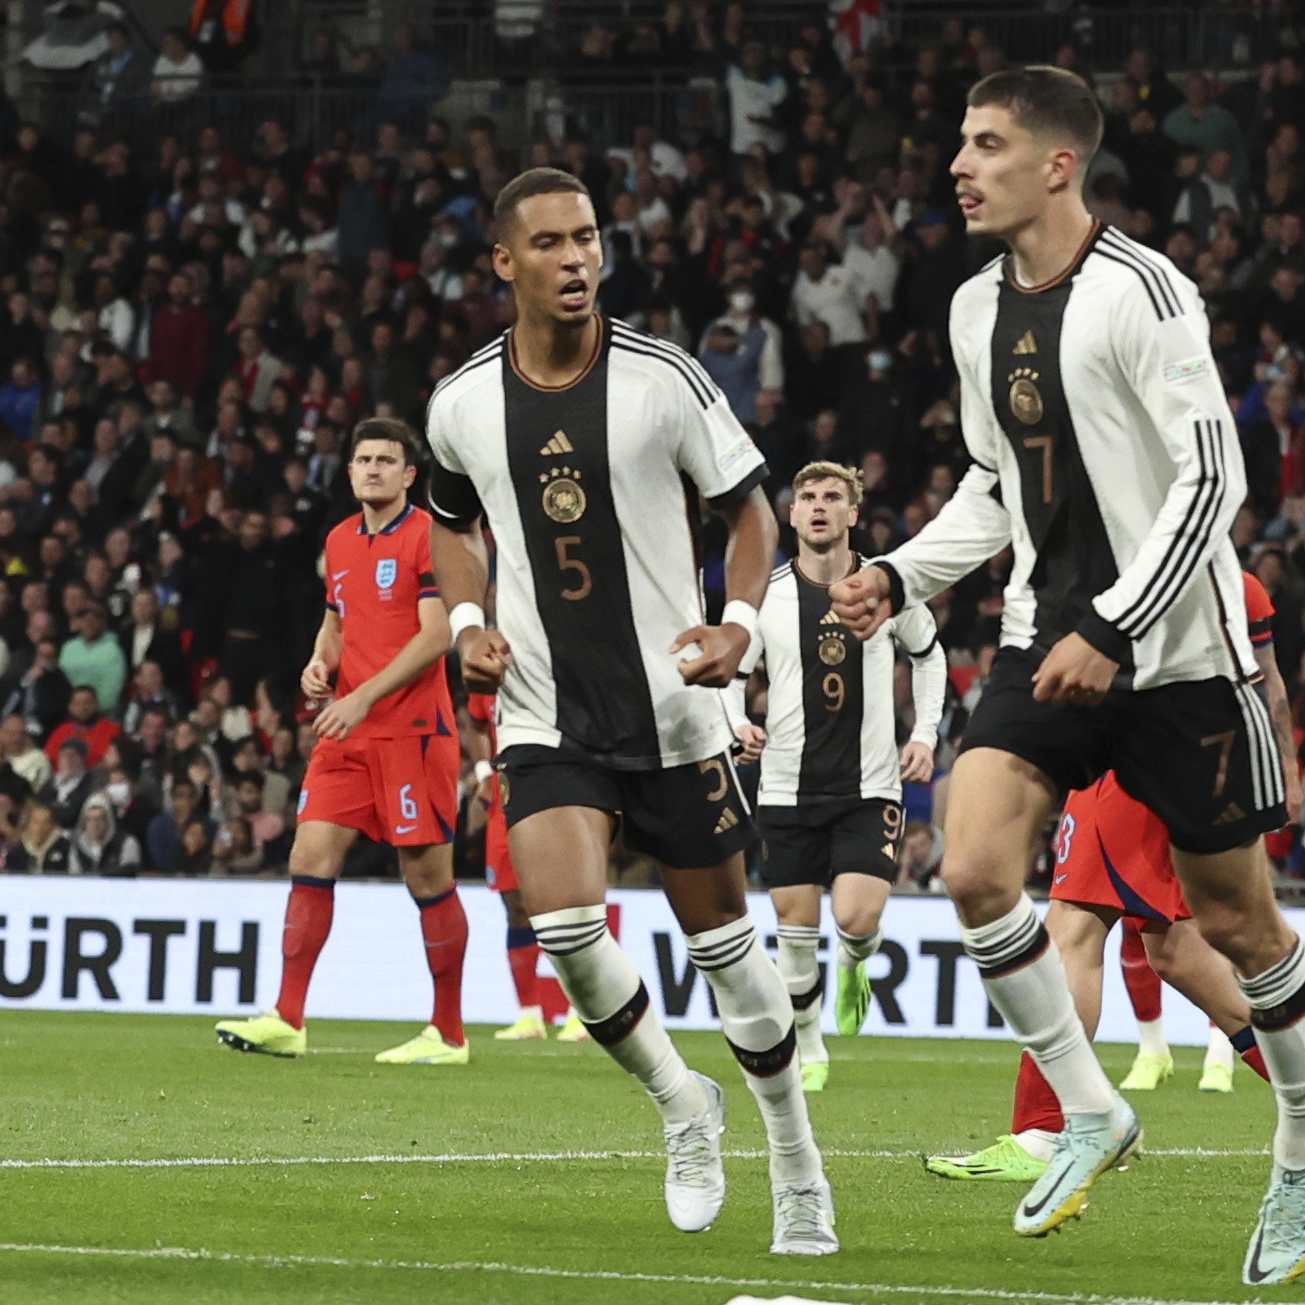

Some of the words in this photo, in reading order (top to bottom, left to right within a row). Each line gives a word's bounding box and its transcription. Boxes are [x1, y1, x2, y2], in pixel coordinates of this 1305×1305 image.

[1022, 435, 1053, 504] 7
[554, 535, 593, 601] 5
[822, 672, 846, 711] 9
[1200, 729, 1236, 798] 7
[399, 782, 418, 819] 6
[882, 804, 902, 840] 9
